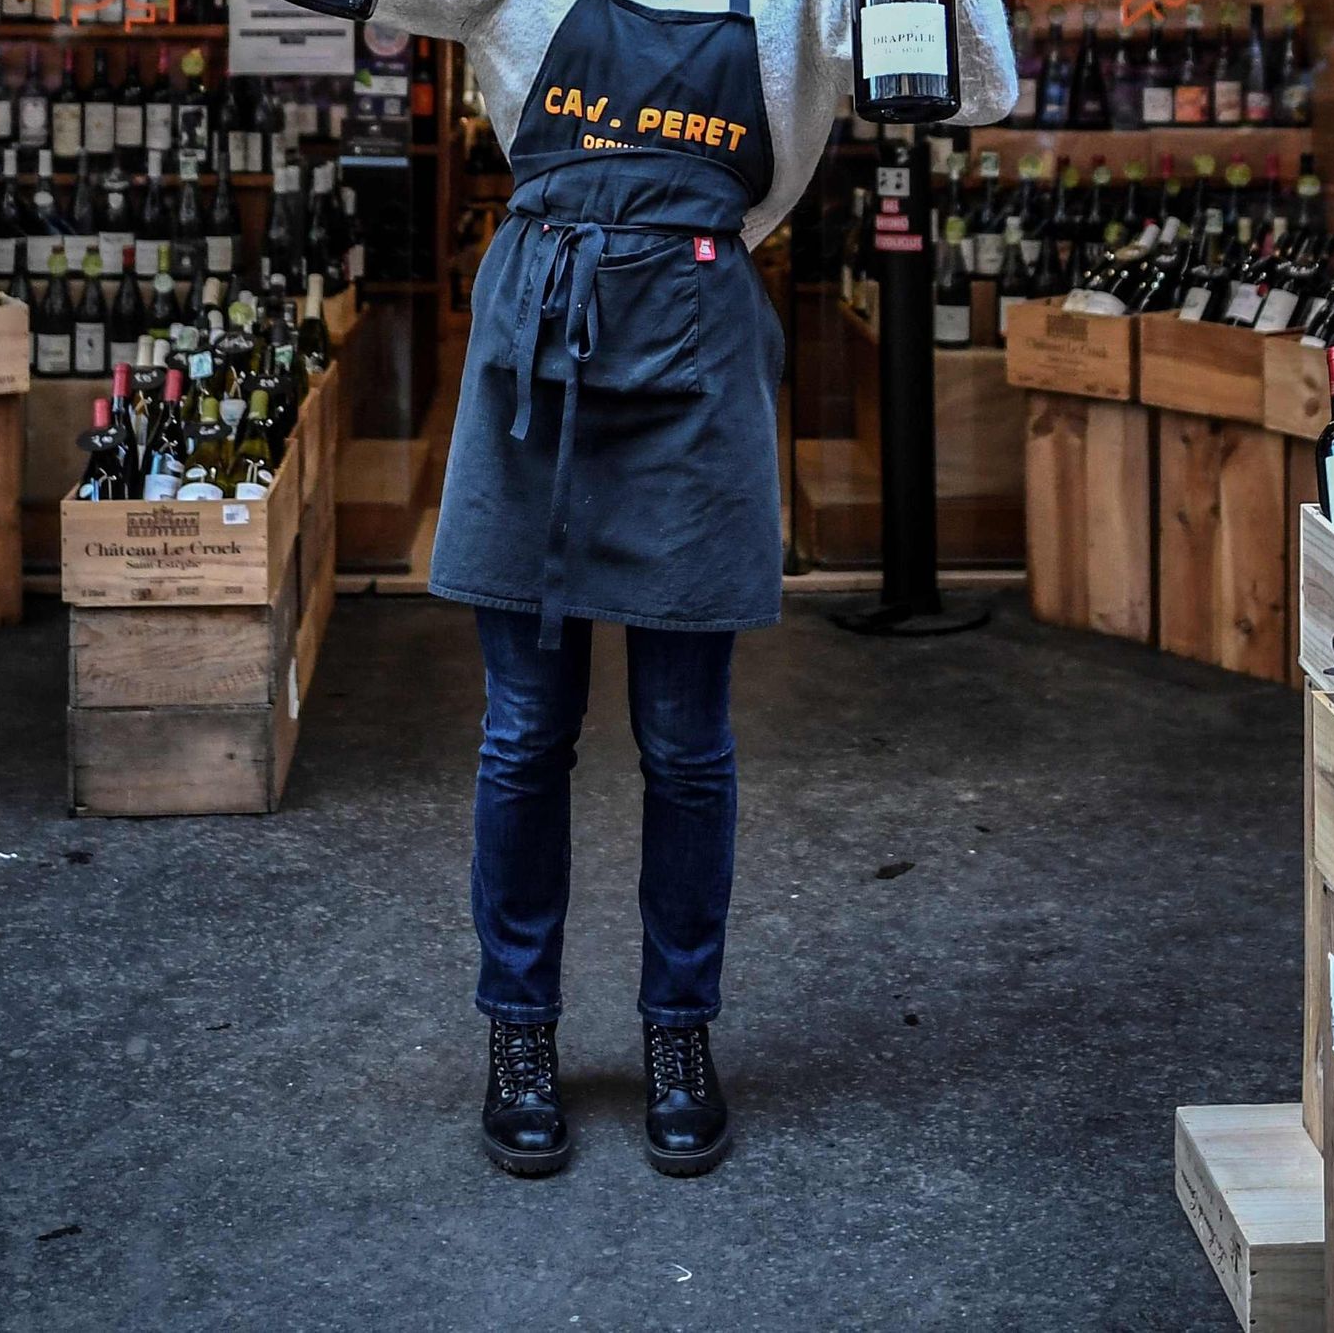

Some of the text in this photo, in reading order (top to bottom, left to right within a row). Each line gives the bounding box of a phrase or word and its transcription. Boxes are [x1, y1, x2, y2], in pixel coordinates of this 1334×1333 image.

[636, 106, 748, 153] PERET
[84, 540, 242, 557] Château Le Crock
